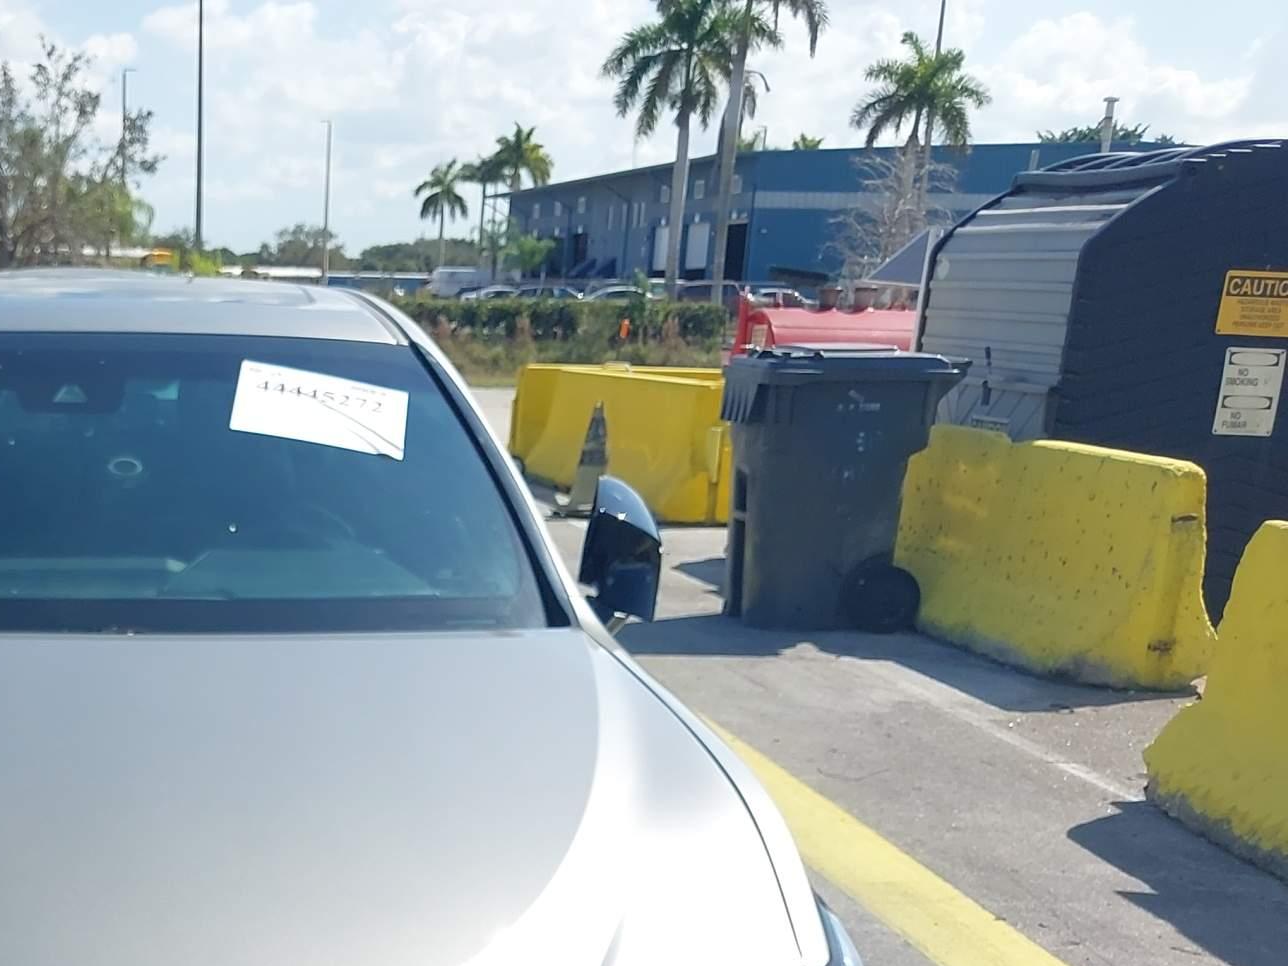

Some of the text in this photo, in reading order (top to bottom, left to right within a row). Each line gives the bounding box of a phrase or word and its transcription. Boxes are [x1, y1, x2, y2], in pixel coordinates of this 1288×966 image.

[1237, 368, 1249, 376] NO
[1225, 377, 1259, 386] SMOKING
[256, 380, 384, 413] 44445272
[1230, 412, 1242, 420] NO
